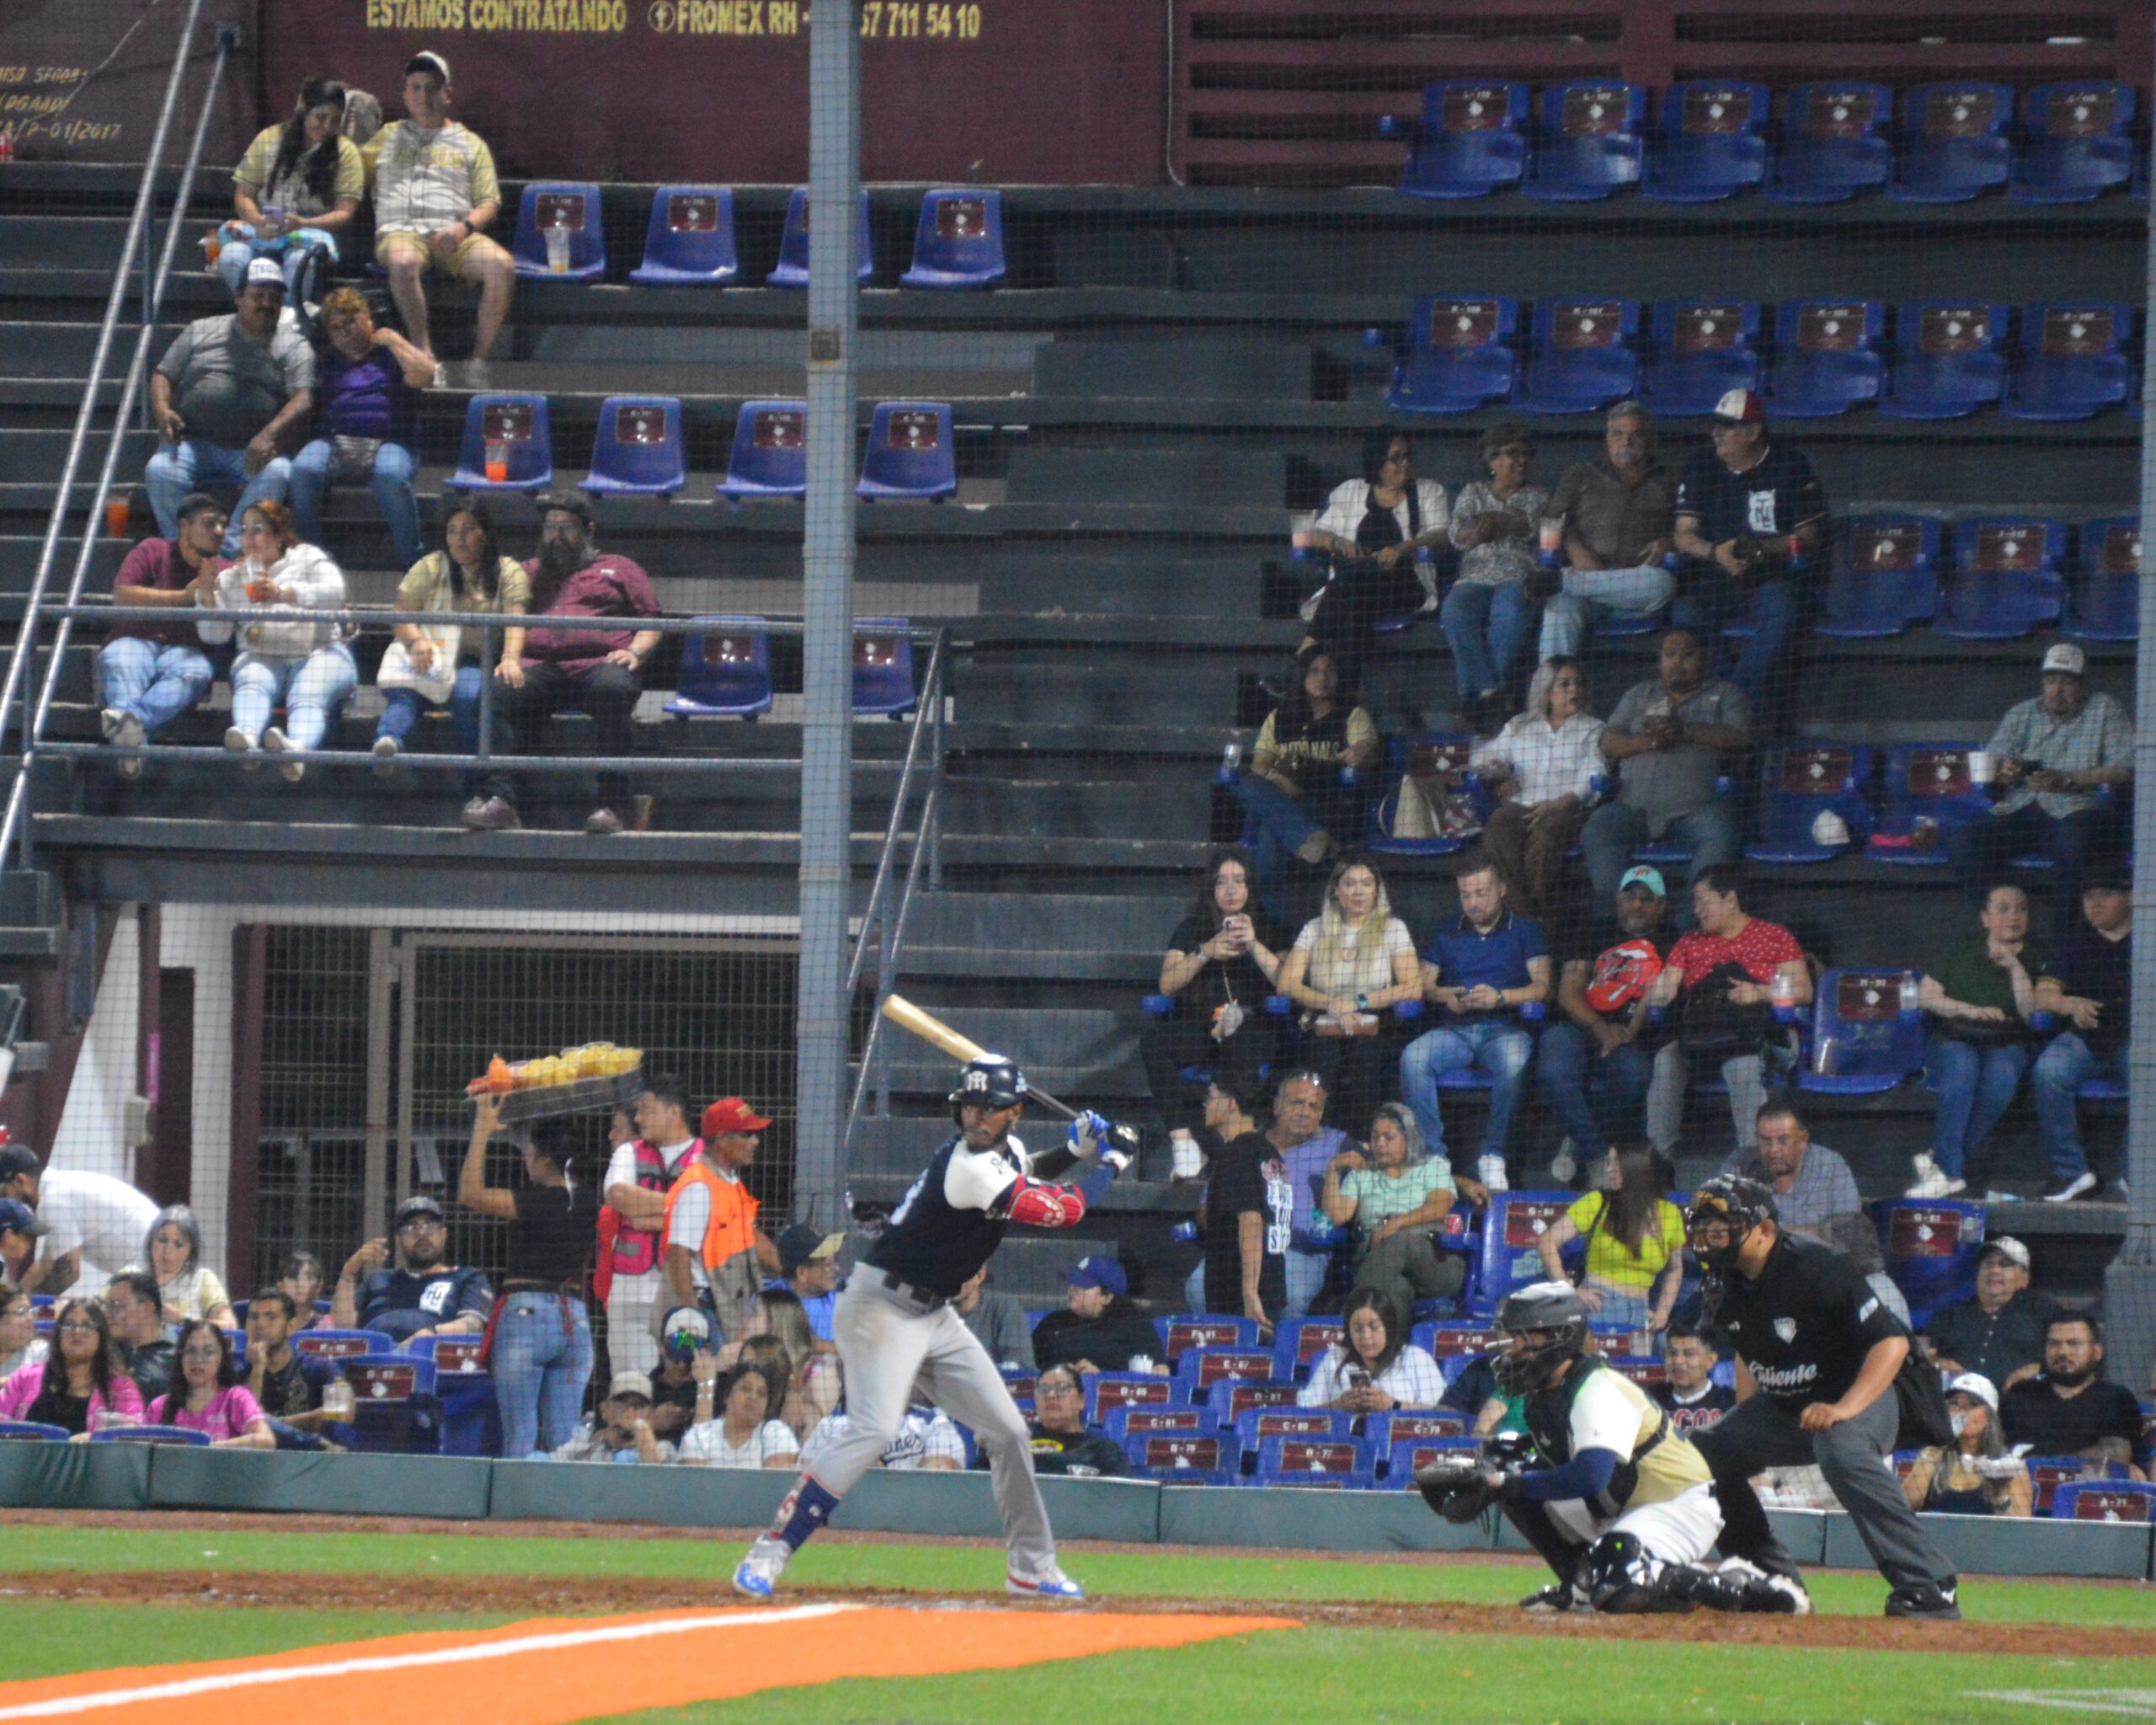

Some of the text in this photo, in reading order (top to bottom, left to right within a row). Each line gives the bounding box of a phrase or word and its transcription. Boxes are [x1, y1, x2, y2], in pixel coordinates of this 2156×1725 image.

[367, 0, 627, 31] ESTAMOS CONTRATANDO
[676, 1, 764, 35] FROMEX
[768, 3, 798, 35] RH
[888, 3, 919, 37] 711
[926, 4, 949, 38] 54
[956, 4, 980, 38] 10
